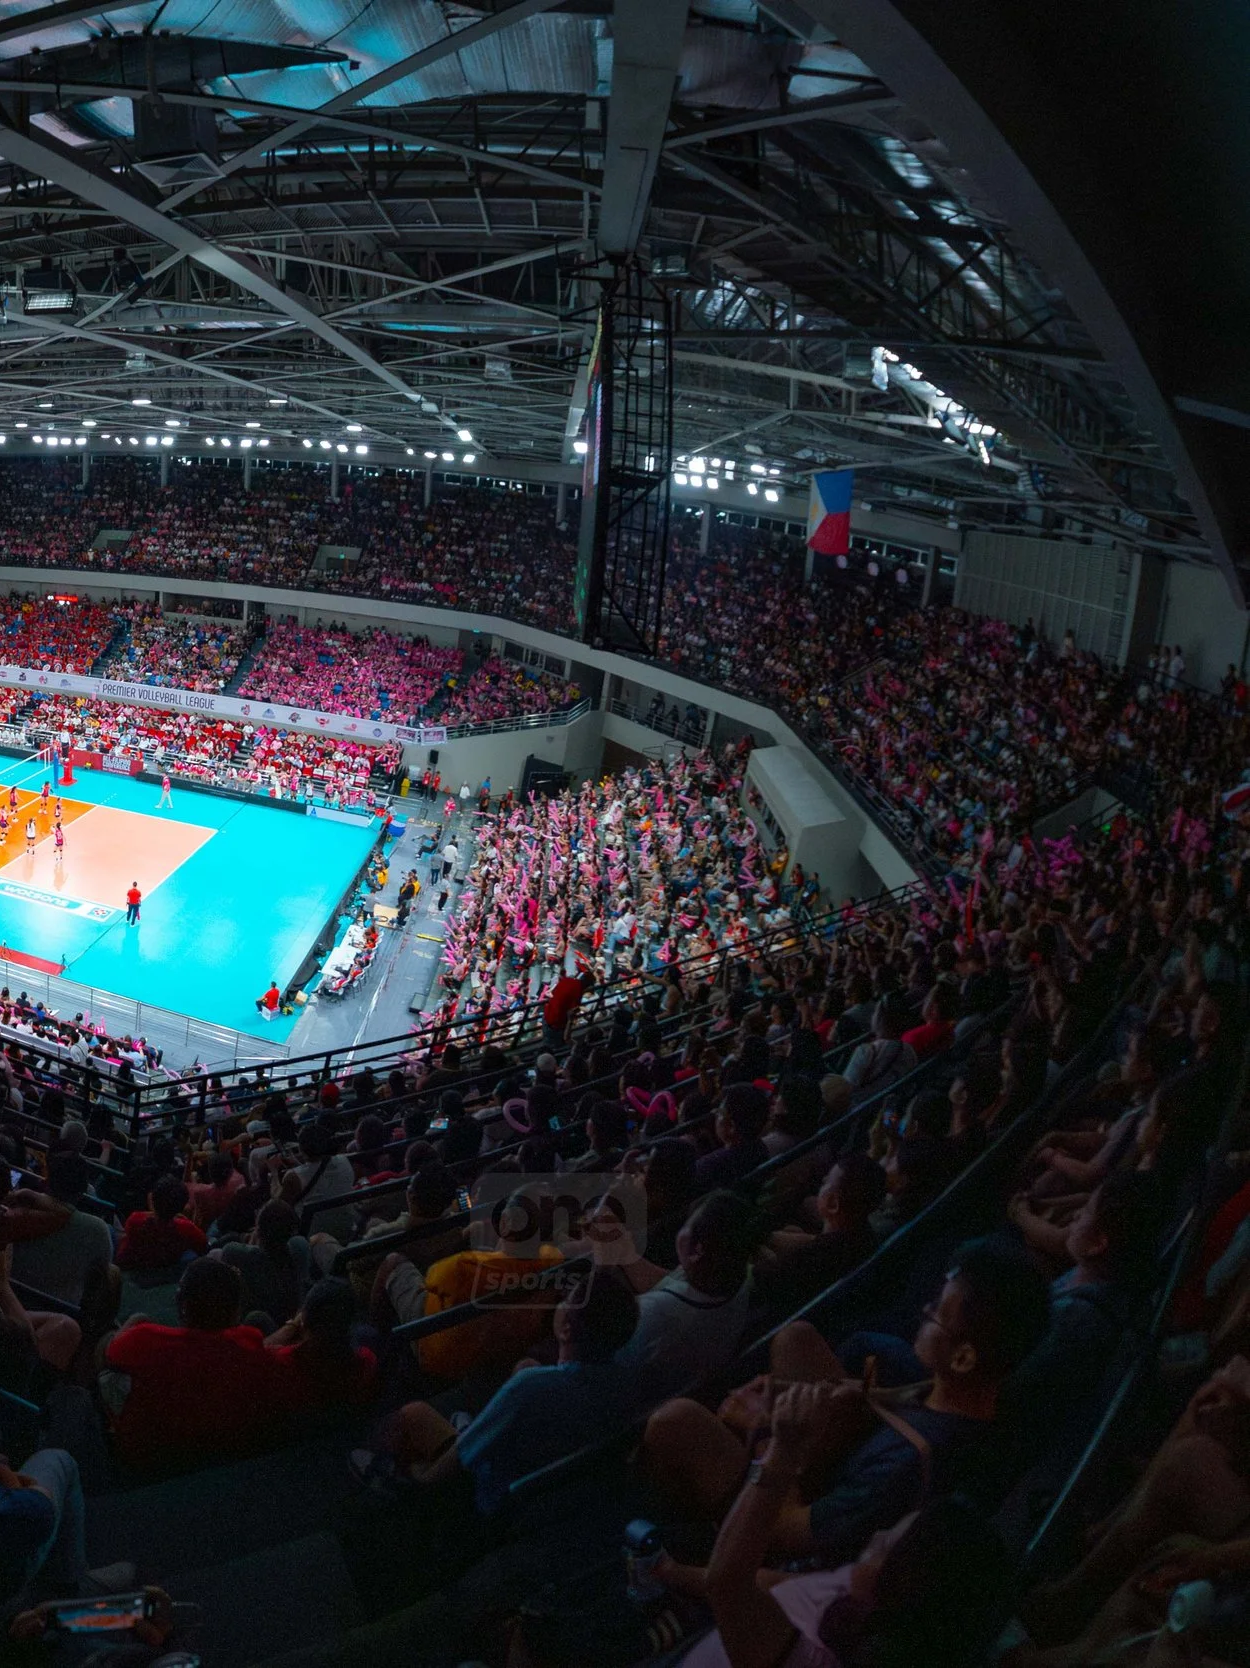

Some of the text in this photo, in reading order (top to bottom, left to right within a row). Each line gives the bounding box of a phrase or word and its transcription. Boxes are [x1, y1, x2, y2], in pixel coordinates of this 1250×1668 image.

[102, 683, 216, 710] PREMIER VOLLEYBALL LEAGUE
